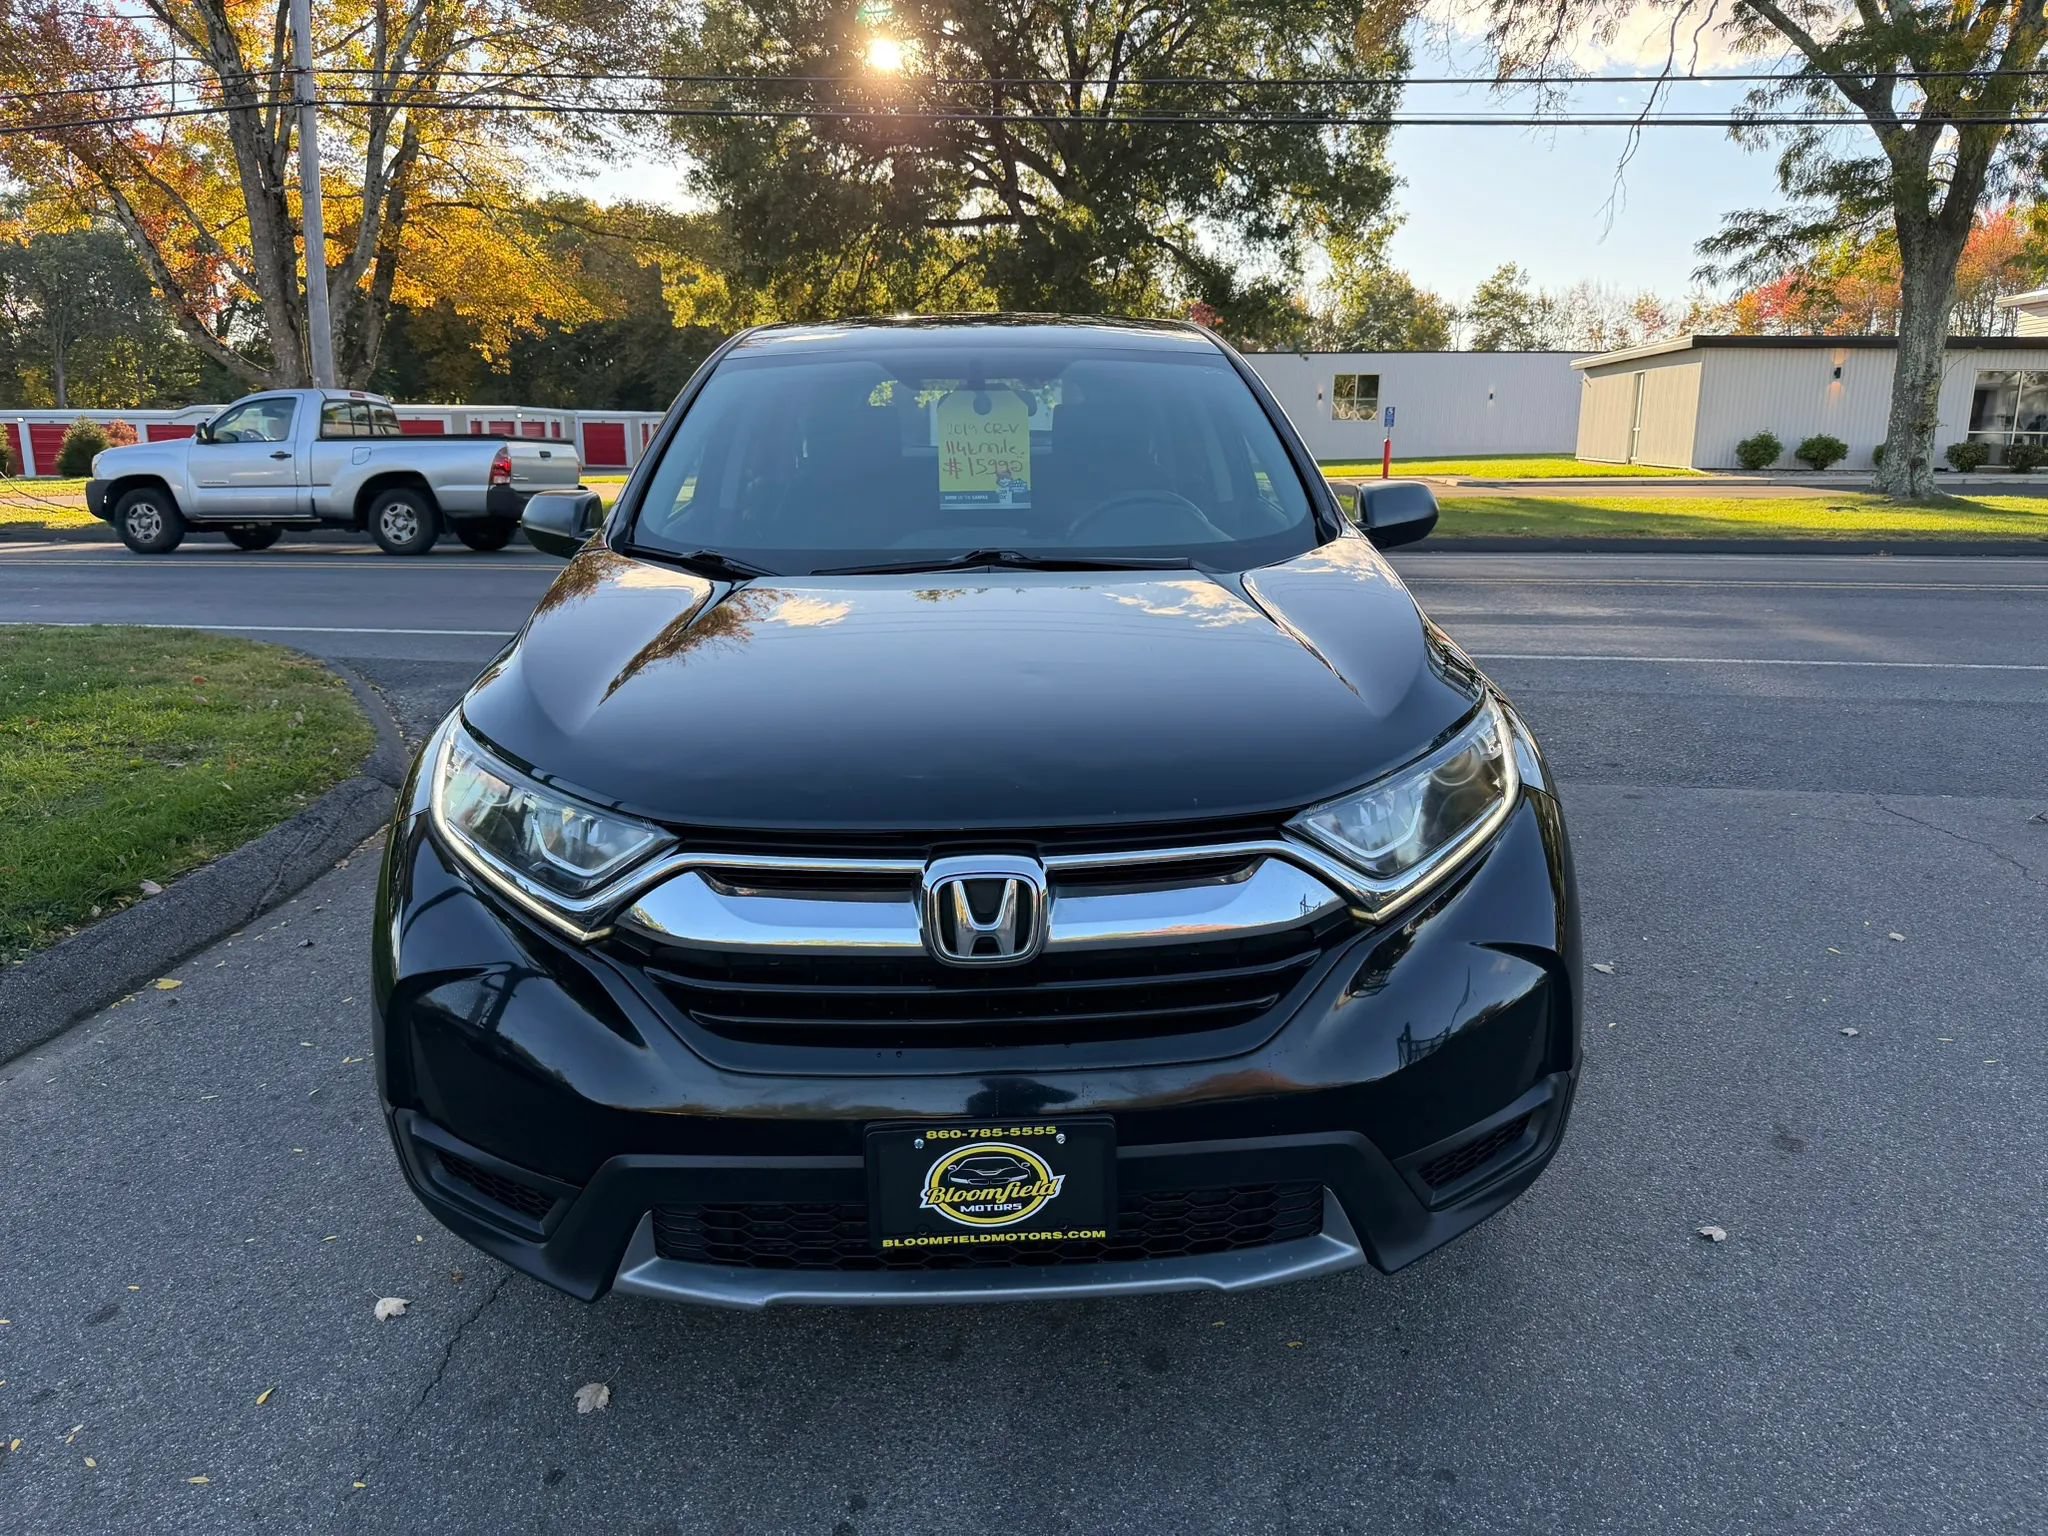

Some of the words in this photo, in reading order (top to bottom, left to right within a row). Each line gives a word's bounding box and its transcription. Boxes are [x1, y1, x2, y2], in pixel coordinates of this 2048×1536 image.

[983, 422, 1020, 435] CR-V
[925, 1126, 1057, 1140] 860-785-5555
[926, 1177, 1061, 1206] Bloomfield
[960, 1202, 1023, 1213] MOTORS
[882, 1230, 1107, 1248] BLOOMFIELDMOTORS.COM
